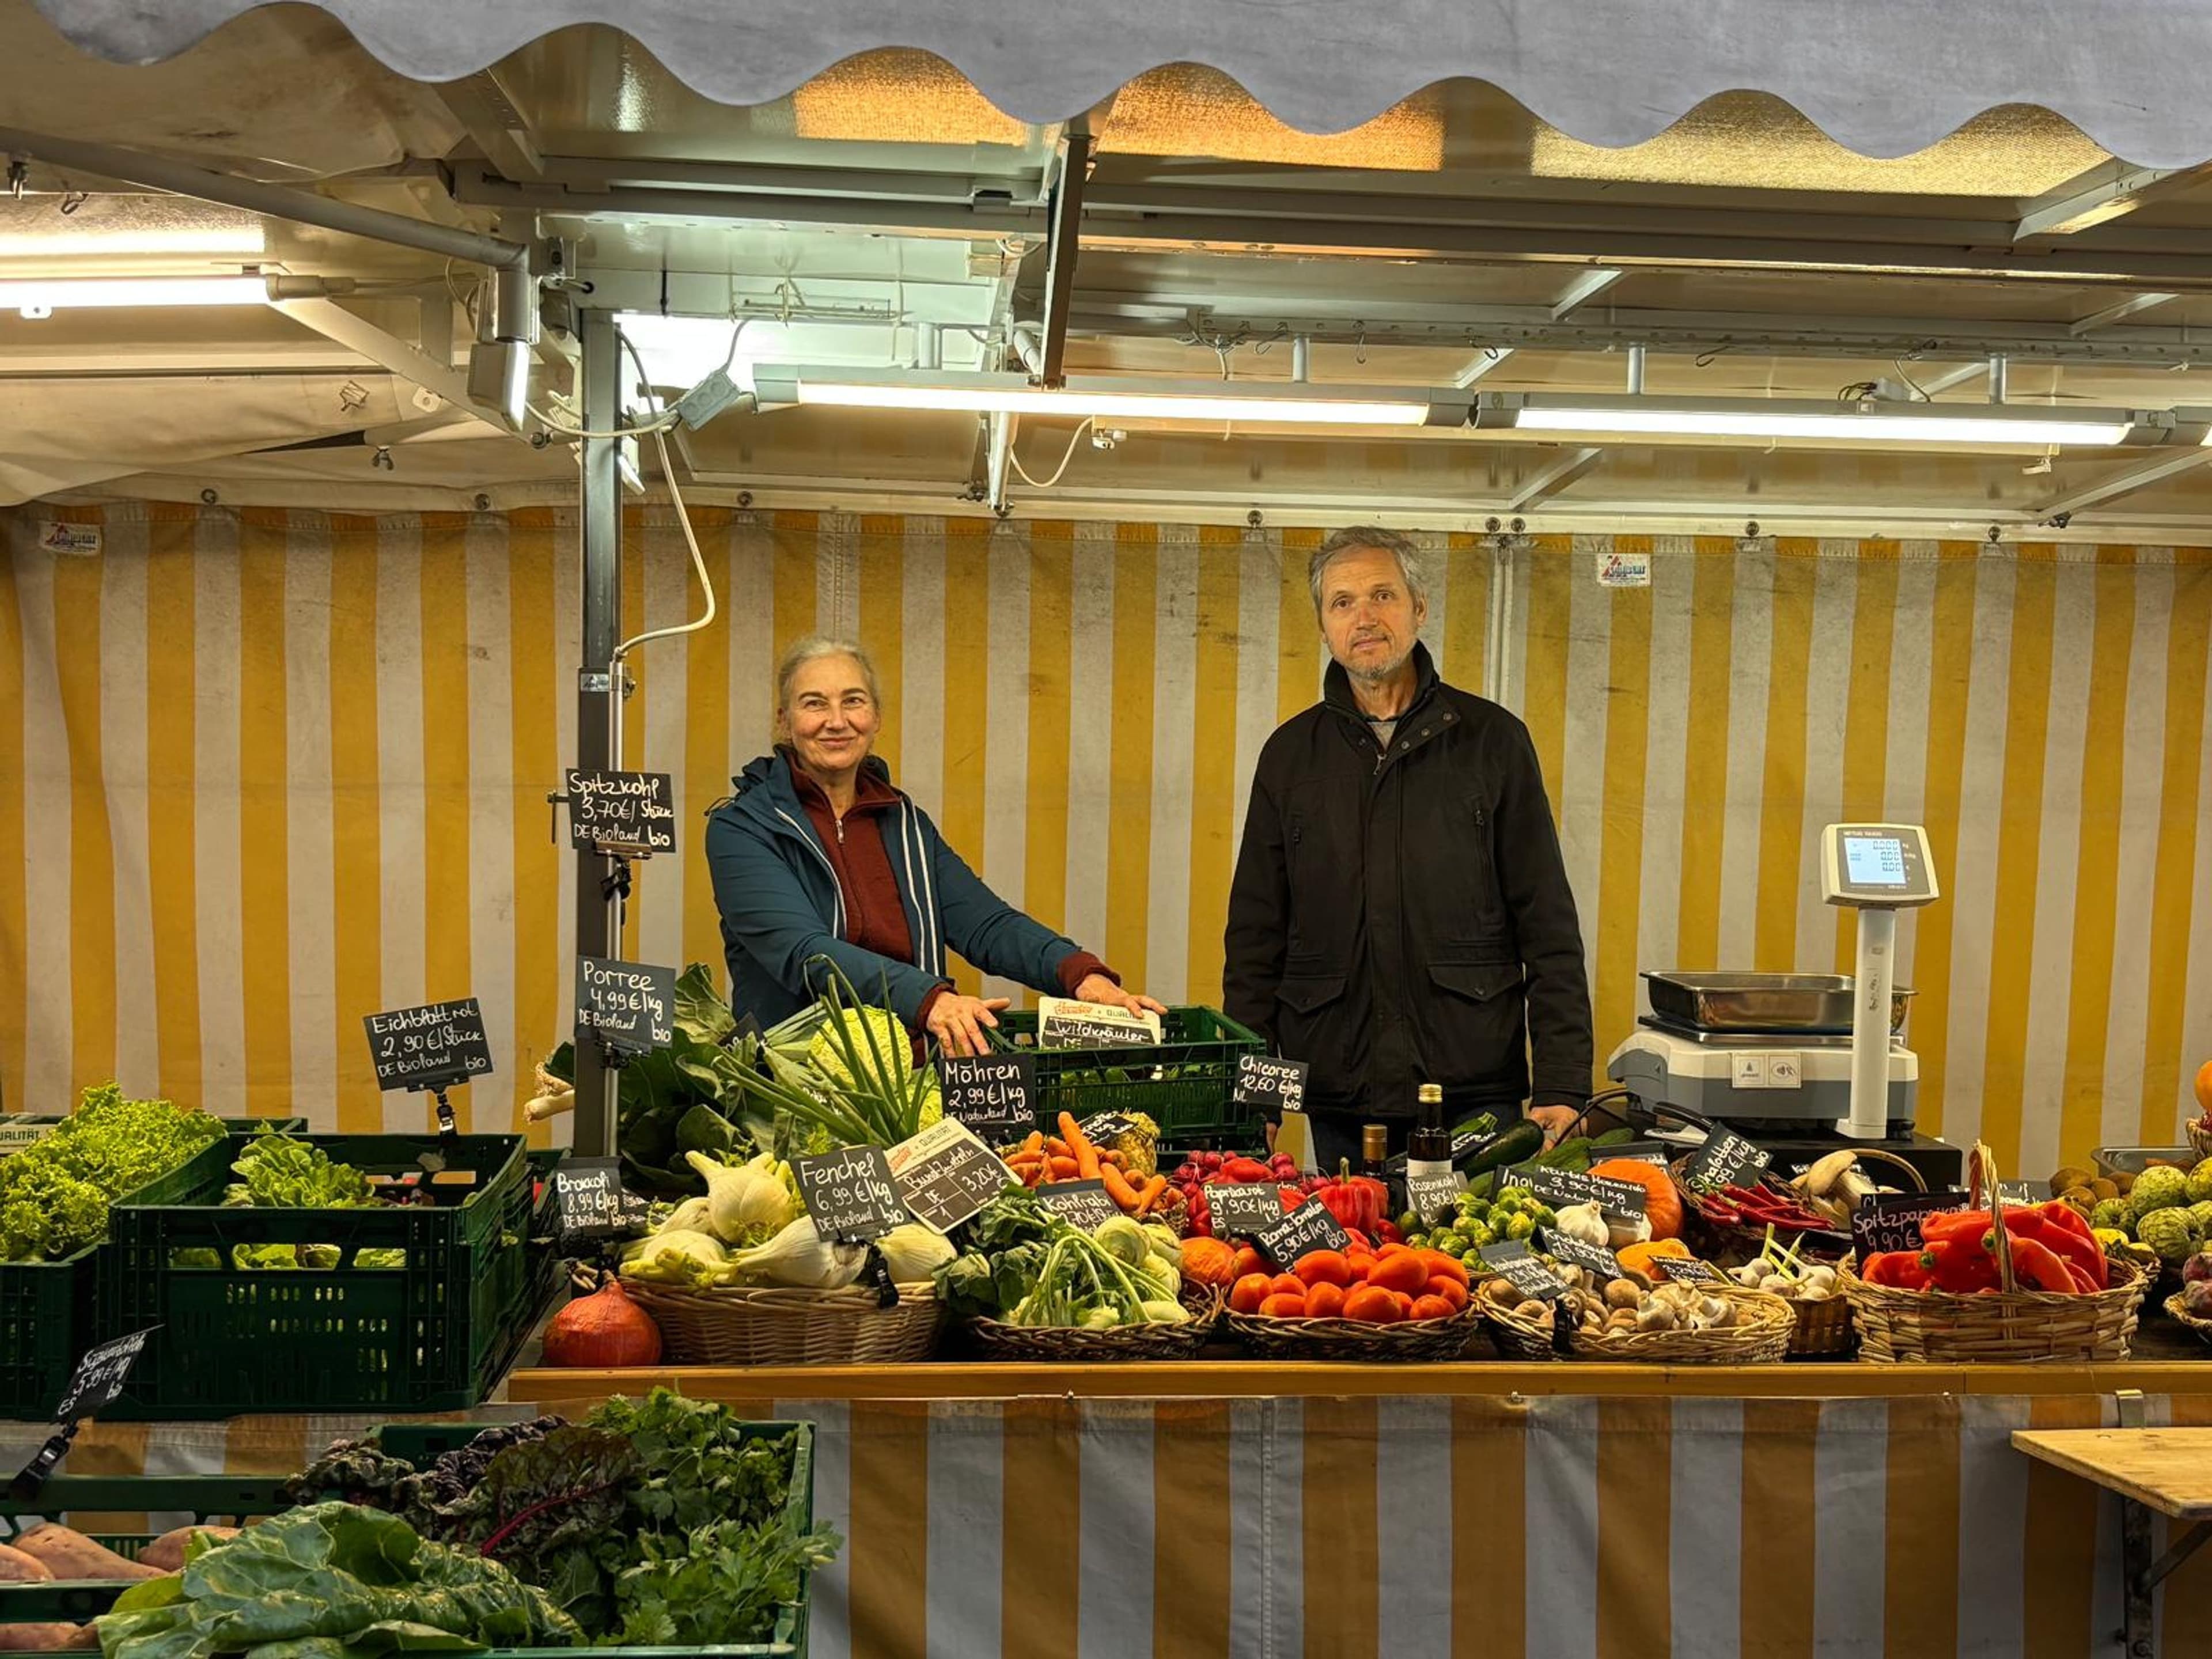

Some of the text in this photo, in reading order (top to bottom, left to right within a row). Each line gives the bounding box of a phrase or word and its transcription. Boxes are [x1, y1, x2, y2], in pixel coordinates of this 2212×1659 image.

[570, 772, 659, 800] Spitzkohl
[593, 824, 641, 842] Bioland
[647, 825, 670, 846] bio
[584, 961, 656, 991] Porree
[372, 1005, 452, 1033] Eichblatt
[593, 1013, 637, 1029] Bioland
[651, 1018, 672, 1042] bio
[377, 1050, 486, 1077] DE Bioland bio
[945, 1059, 1021, 1085] Möhren
[1240, 1055, 1300, 1080] Chicoree
[1233, 1088, 1301, 1110] NL bio
[1012, 1104, 1033, 1123] bio
[800, 1152, 876, 1187] Fenchel
[1751, 1151, 1769, 1168] bio
[1042, 1192, 1111, 1211] Kohlrabi
[1620, 1207, 1642, 1218] bio
[611, 1212, 627, 1226] bio
[816, 1204, 904, 1232] DE Bioland bio
